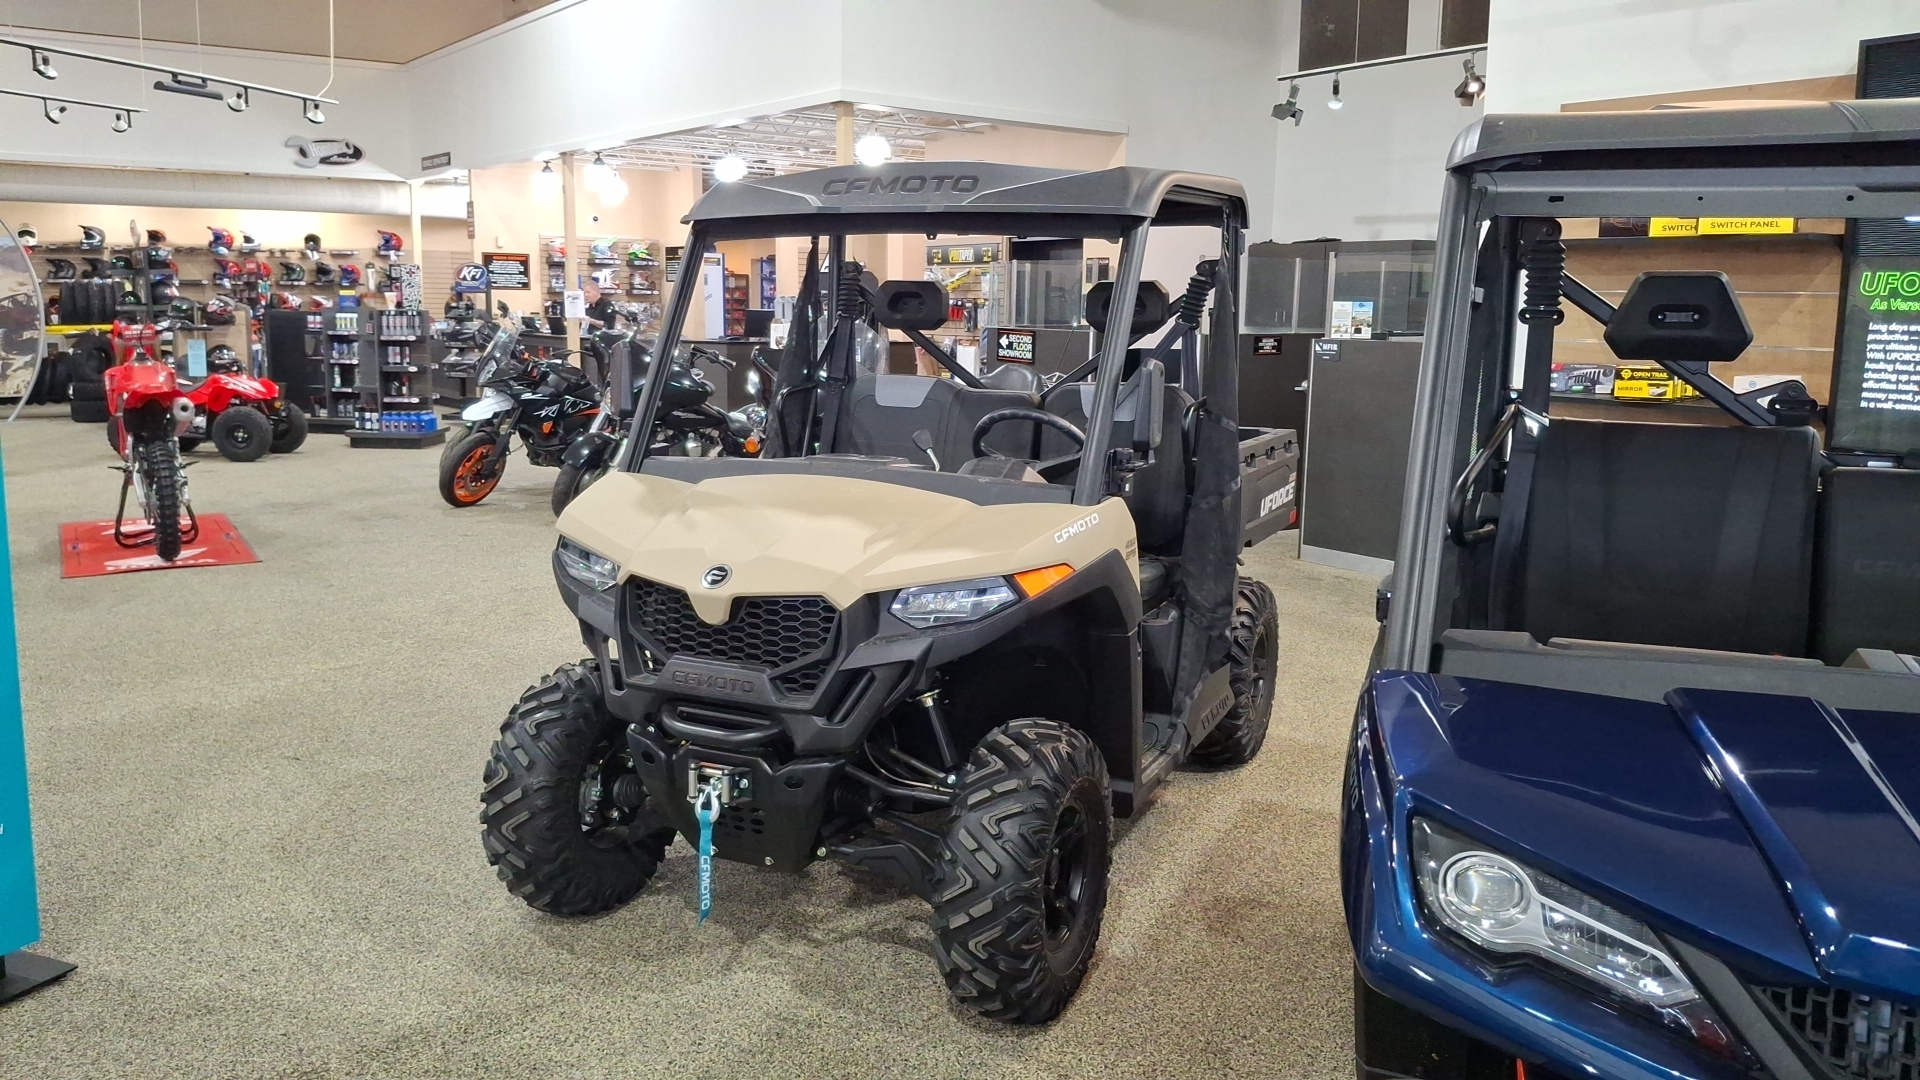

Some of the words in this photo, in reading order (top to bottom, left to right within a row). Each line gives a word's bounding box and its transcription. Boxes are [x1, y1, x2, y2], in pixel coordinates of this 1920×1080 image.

[821, 175, 980, 197] CFMOTO
[1661, 224, 1697, 232] SWITCH
[1710, 221, 1748, 229] SWITCH
[1750, 220, 1780, 228] PANEL
[1860, 271, 1920, 296] UFO
[1870, 298, 1888, 310] As
[1868, 322, 1888, 333] Long
[1888, 322, 1908, 333] days
[1008, 335, 1033, 343] SECOND
[1867, 332, 1909, 342] productive
[1866, 343, 1885, 351] your
[1885, 342, 1917, 351] ultimate
[998, 349, 1033, 358] SHOWROOM
[1866, 351, 1885, 360] With
[1864, 361, 1894, 372] hauling
[1863, 371, 1898, 382] checking
[1898, 374, 1909, 382] up
[1862, 381, 1897, 390] effortless
[1861, 391, 1887, 401] money
[1260, 481, 1296, 518] UFORCE
[1053, 512, 1099, 544] CFMOTO
[672, 670, 755, 693] CFMOTO
[701, 855, 711, 910] CFMOTO
